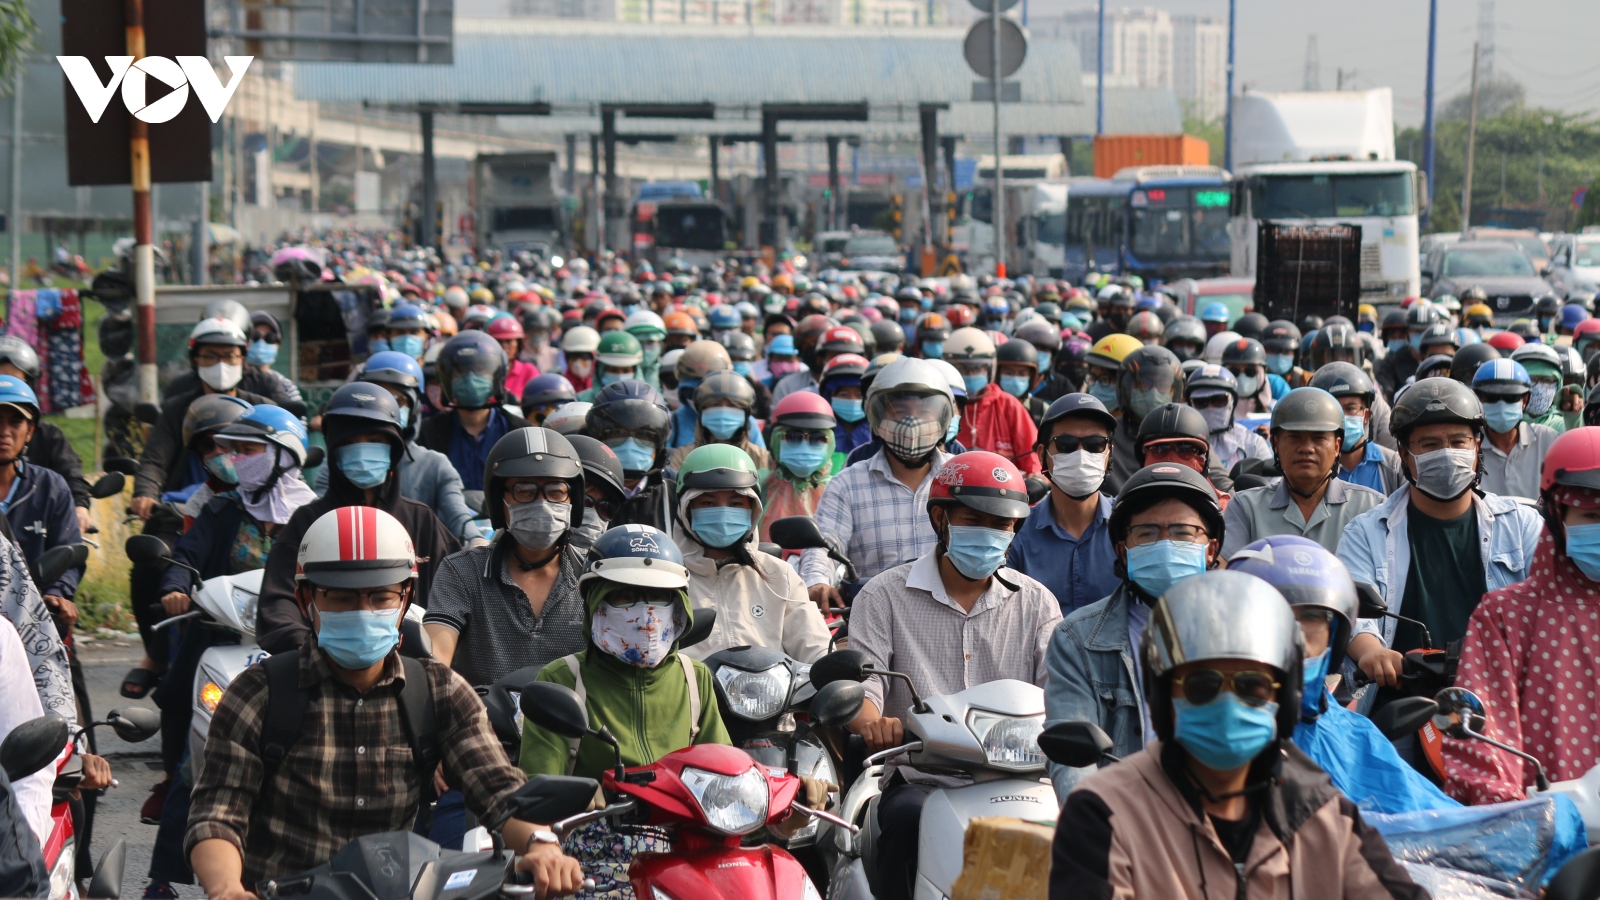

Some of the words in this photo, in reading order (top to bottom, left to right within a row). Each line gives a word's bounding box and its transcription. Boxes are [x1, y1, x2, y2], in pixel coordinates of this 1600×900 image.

[1287, 565, 1320, 577] YAMAHA
[989, 795, 1043, 804] HONDA
[717, 861, 751, 869] HONDA
